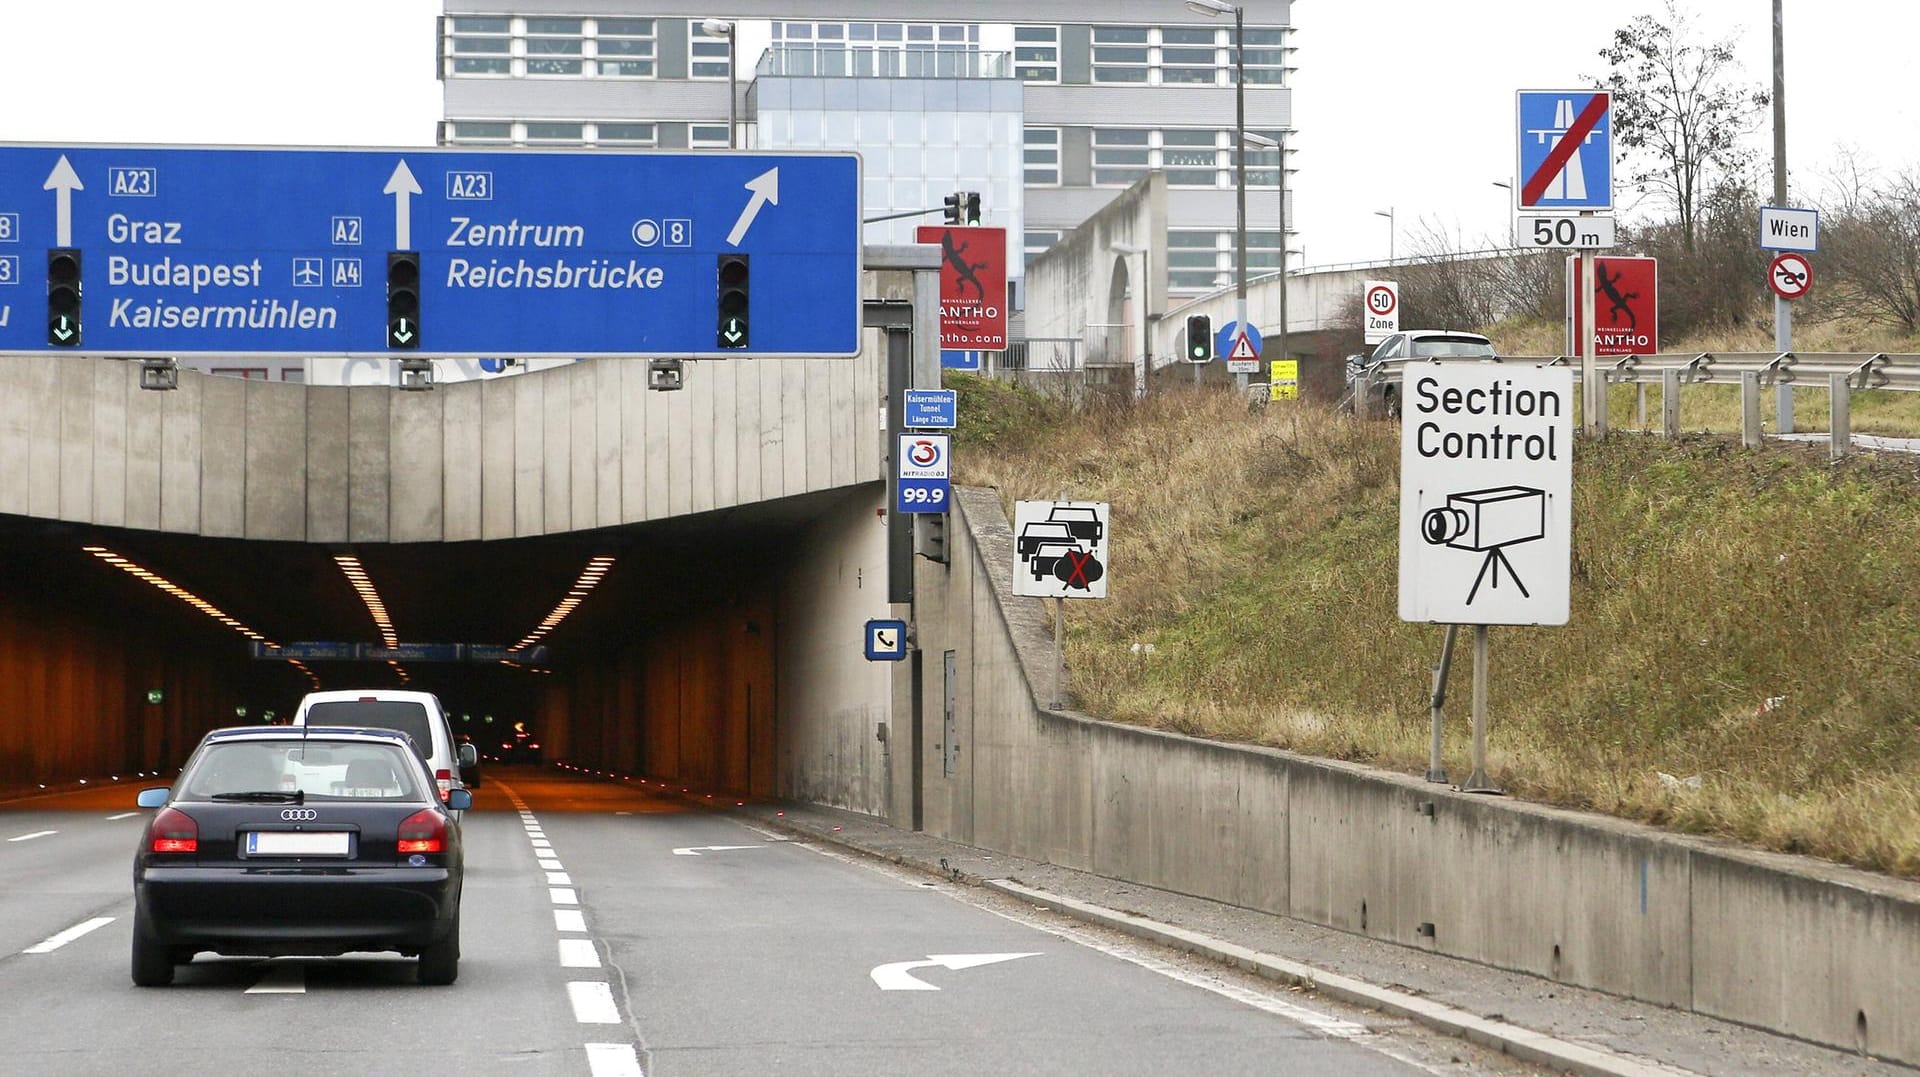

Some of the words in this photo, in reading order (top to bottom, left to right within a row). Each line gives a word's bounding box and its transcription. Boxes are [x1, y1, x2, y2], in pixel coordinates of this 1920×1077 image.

[115, 171, 151, 194] A23
[452, 175, 488, 198] A23
[108, 213, 182, 244] Graz
[335, 220, 358, 241] A2
[447, 216, 584, 247] Zentrum
[670, 222, 684, 243] 8
[1534, 219, 1576, 246] 50
[1581, 231, 1599, 246] m
[1770, 219, 1809, 237] Wien
[109, 256, 261, 293] Budapest
[335, 263, 359, 284] A4
[447, 259, 664, 289] Reichsbrücke
[1374, 293, 1388, 308] 50
[109, 298, 336, 329] Kaisermühlen
[939, 307, 998, 318] ANTHO
[1369, 317, 1393, 330] Zone
[940, 333, 1002, 343] ntho.com
[1593, 335, 1648, 346] ANTHO
[907, 394, 954, 404] Kaisermühlen-
[1416, 377, 1560, 417] Section
[920, 404, 941, 413] Tunnel
[1417, 422, 1557, 460] Control
[903, 488, 944, 503] 99.9
